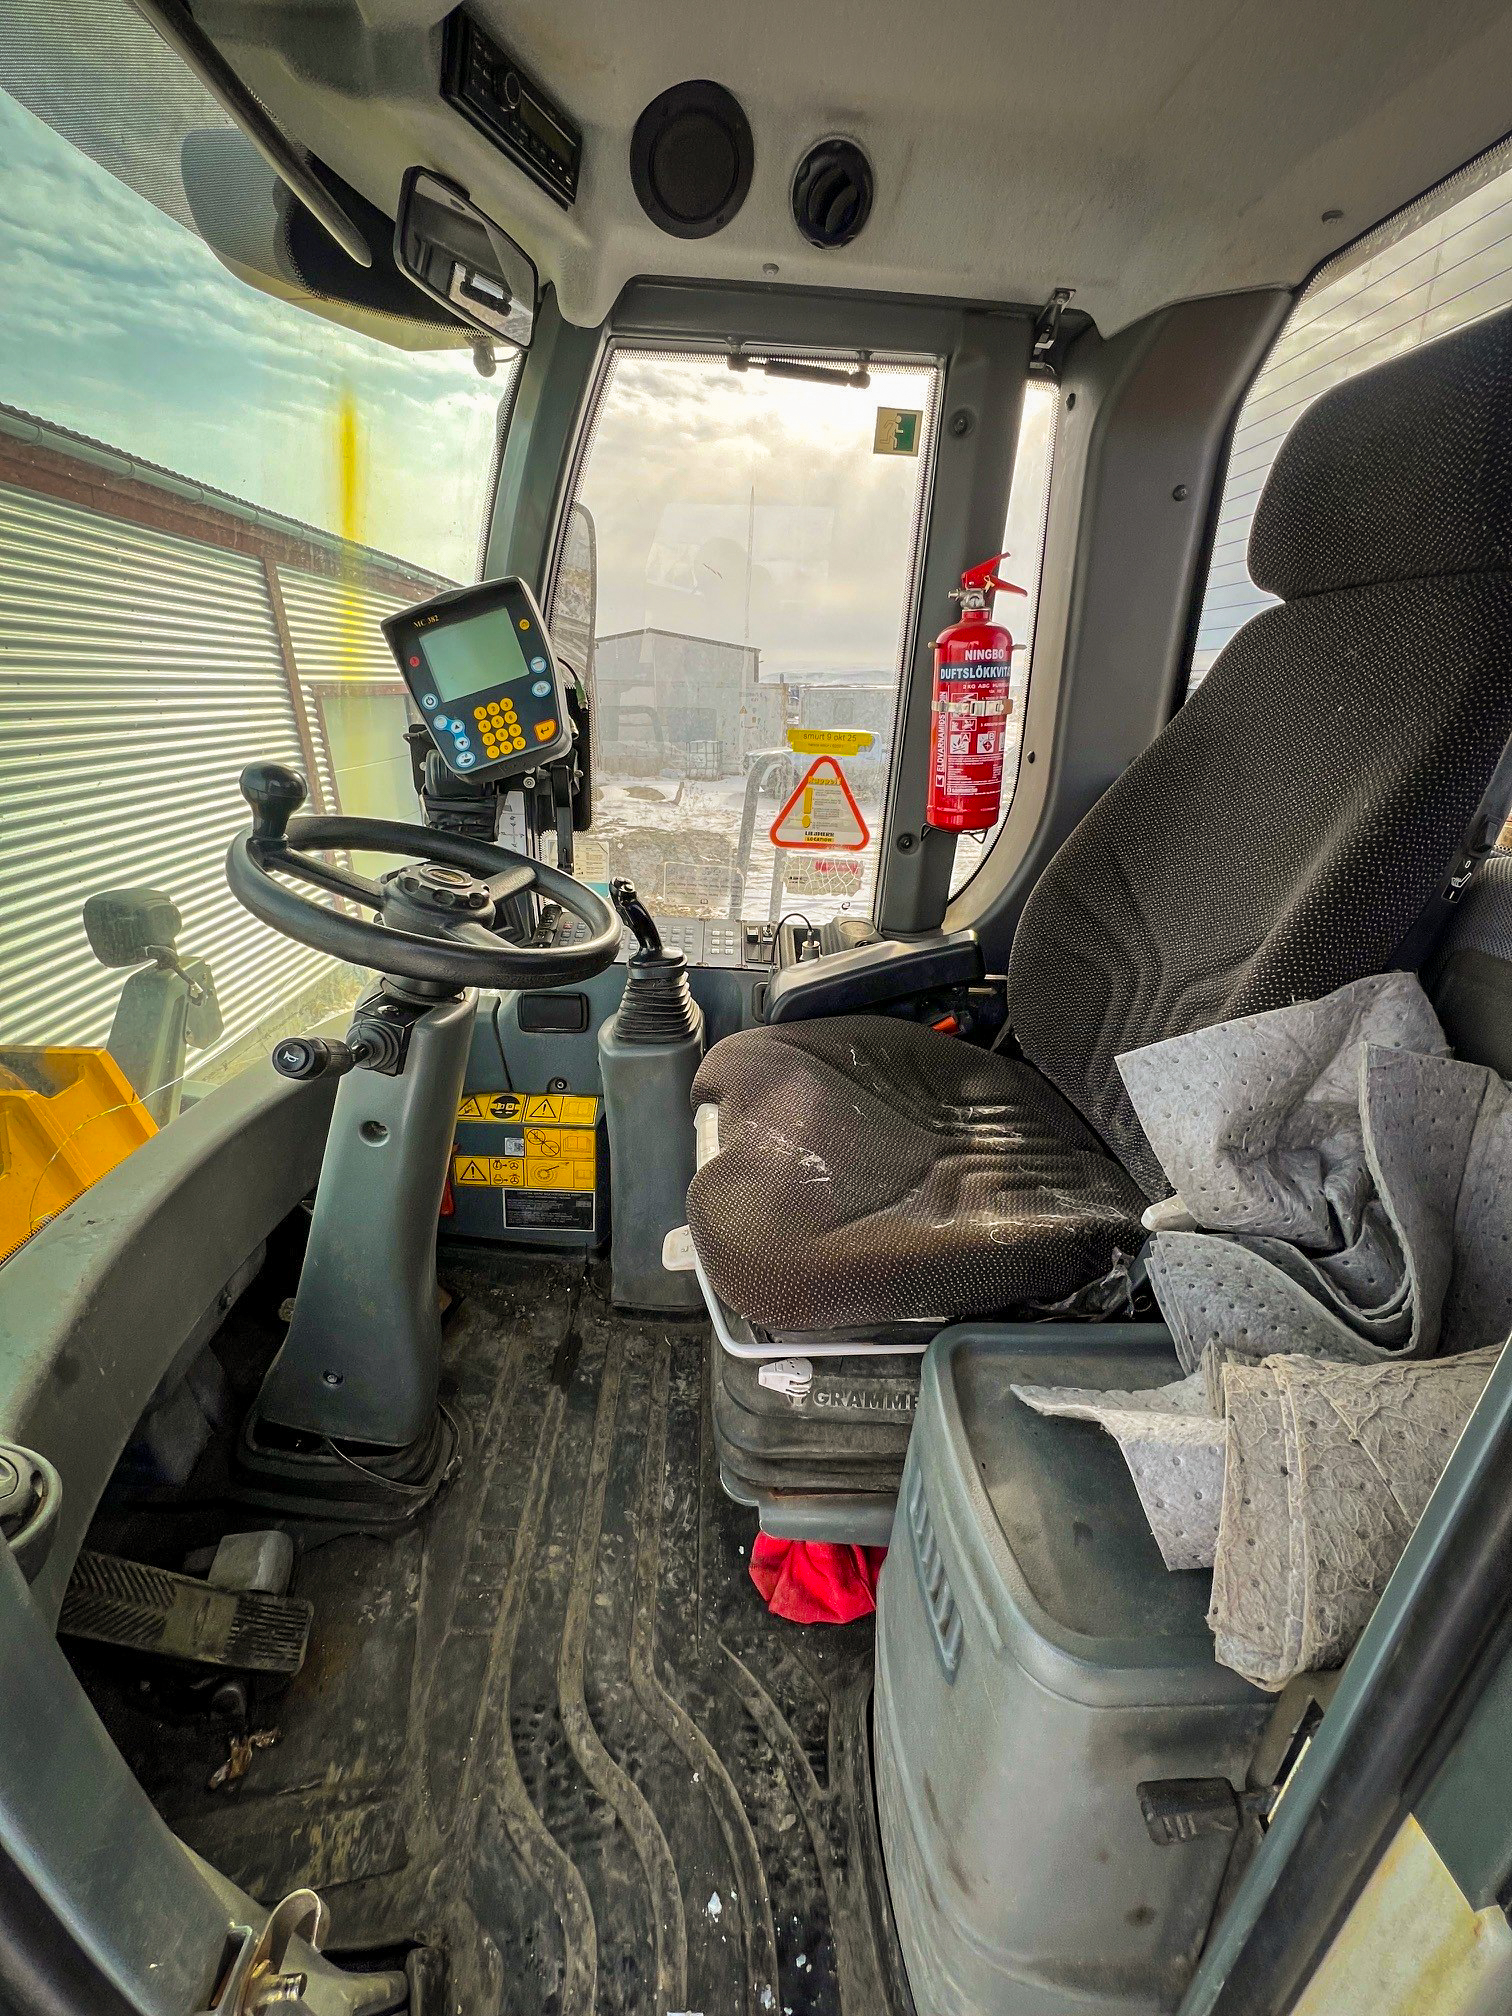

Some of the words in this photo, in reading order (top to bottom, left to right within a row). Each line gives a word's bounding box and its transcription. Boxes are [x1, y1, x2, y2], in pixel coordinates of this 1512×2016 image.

[965, 648, 1005, 660] NINGBO
[803, 733, 825, 741] smurt
[833, 734, 845, 742] okt
[847, 734, 857, 742] 25
